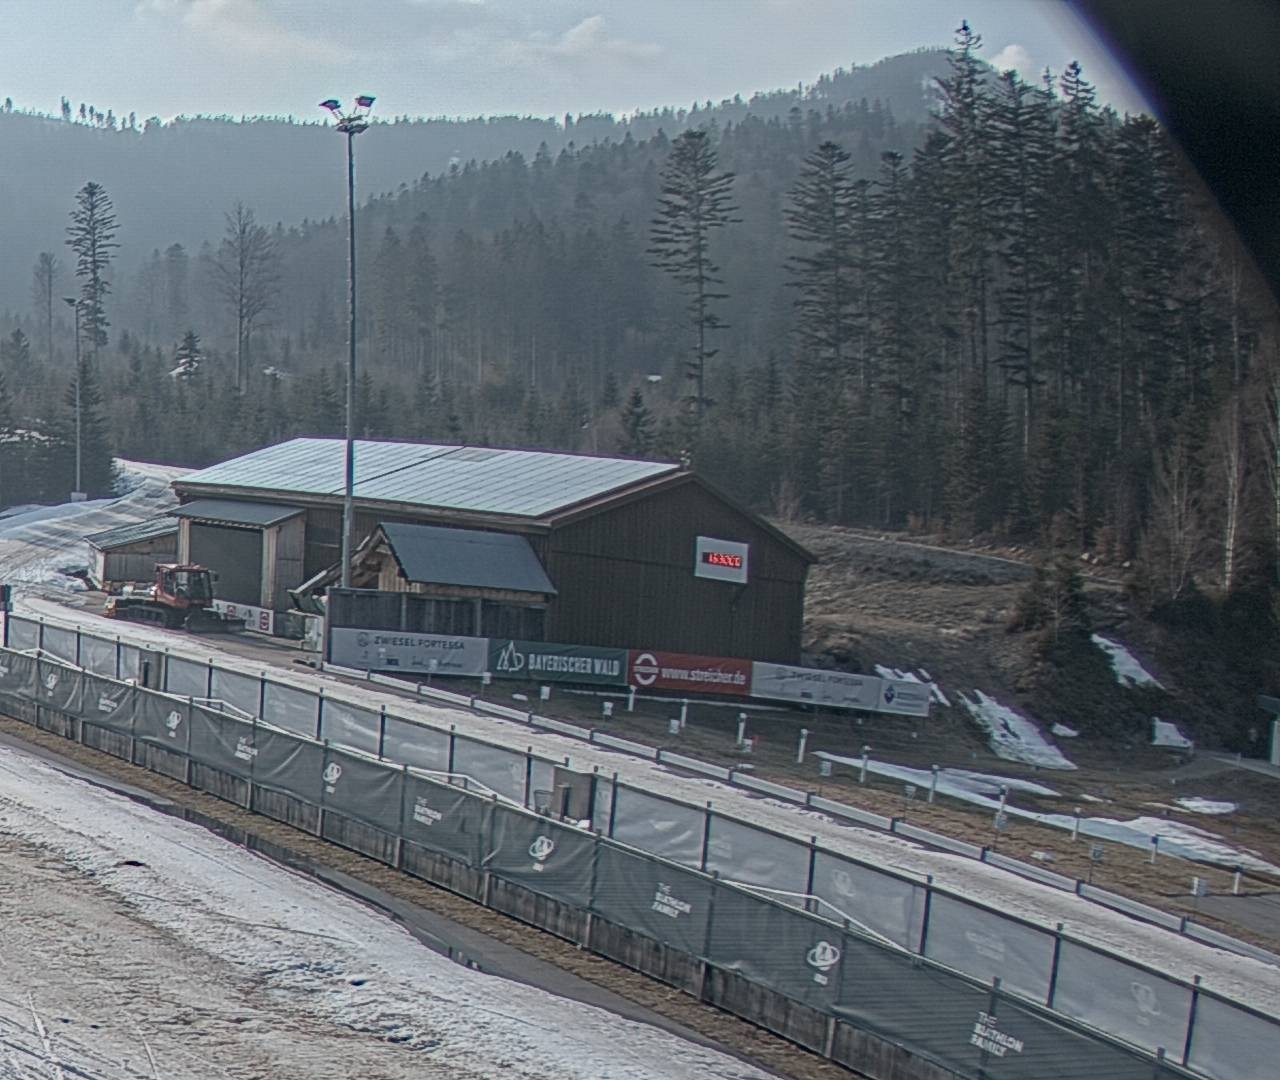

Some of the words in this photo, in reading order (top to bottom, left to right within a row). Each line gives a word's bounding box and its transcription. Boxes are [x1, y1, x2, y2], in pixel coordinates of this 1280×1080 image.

[528, 653, 593, 674] BAYERISCHER
[594, 658, 620, 676] WALD
[661, 667, 746, 686] www.streicher.de
